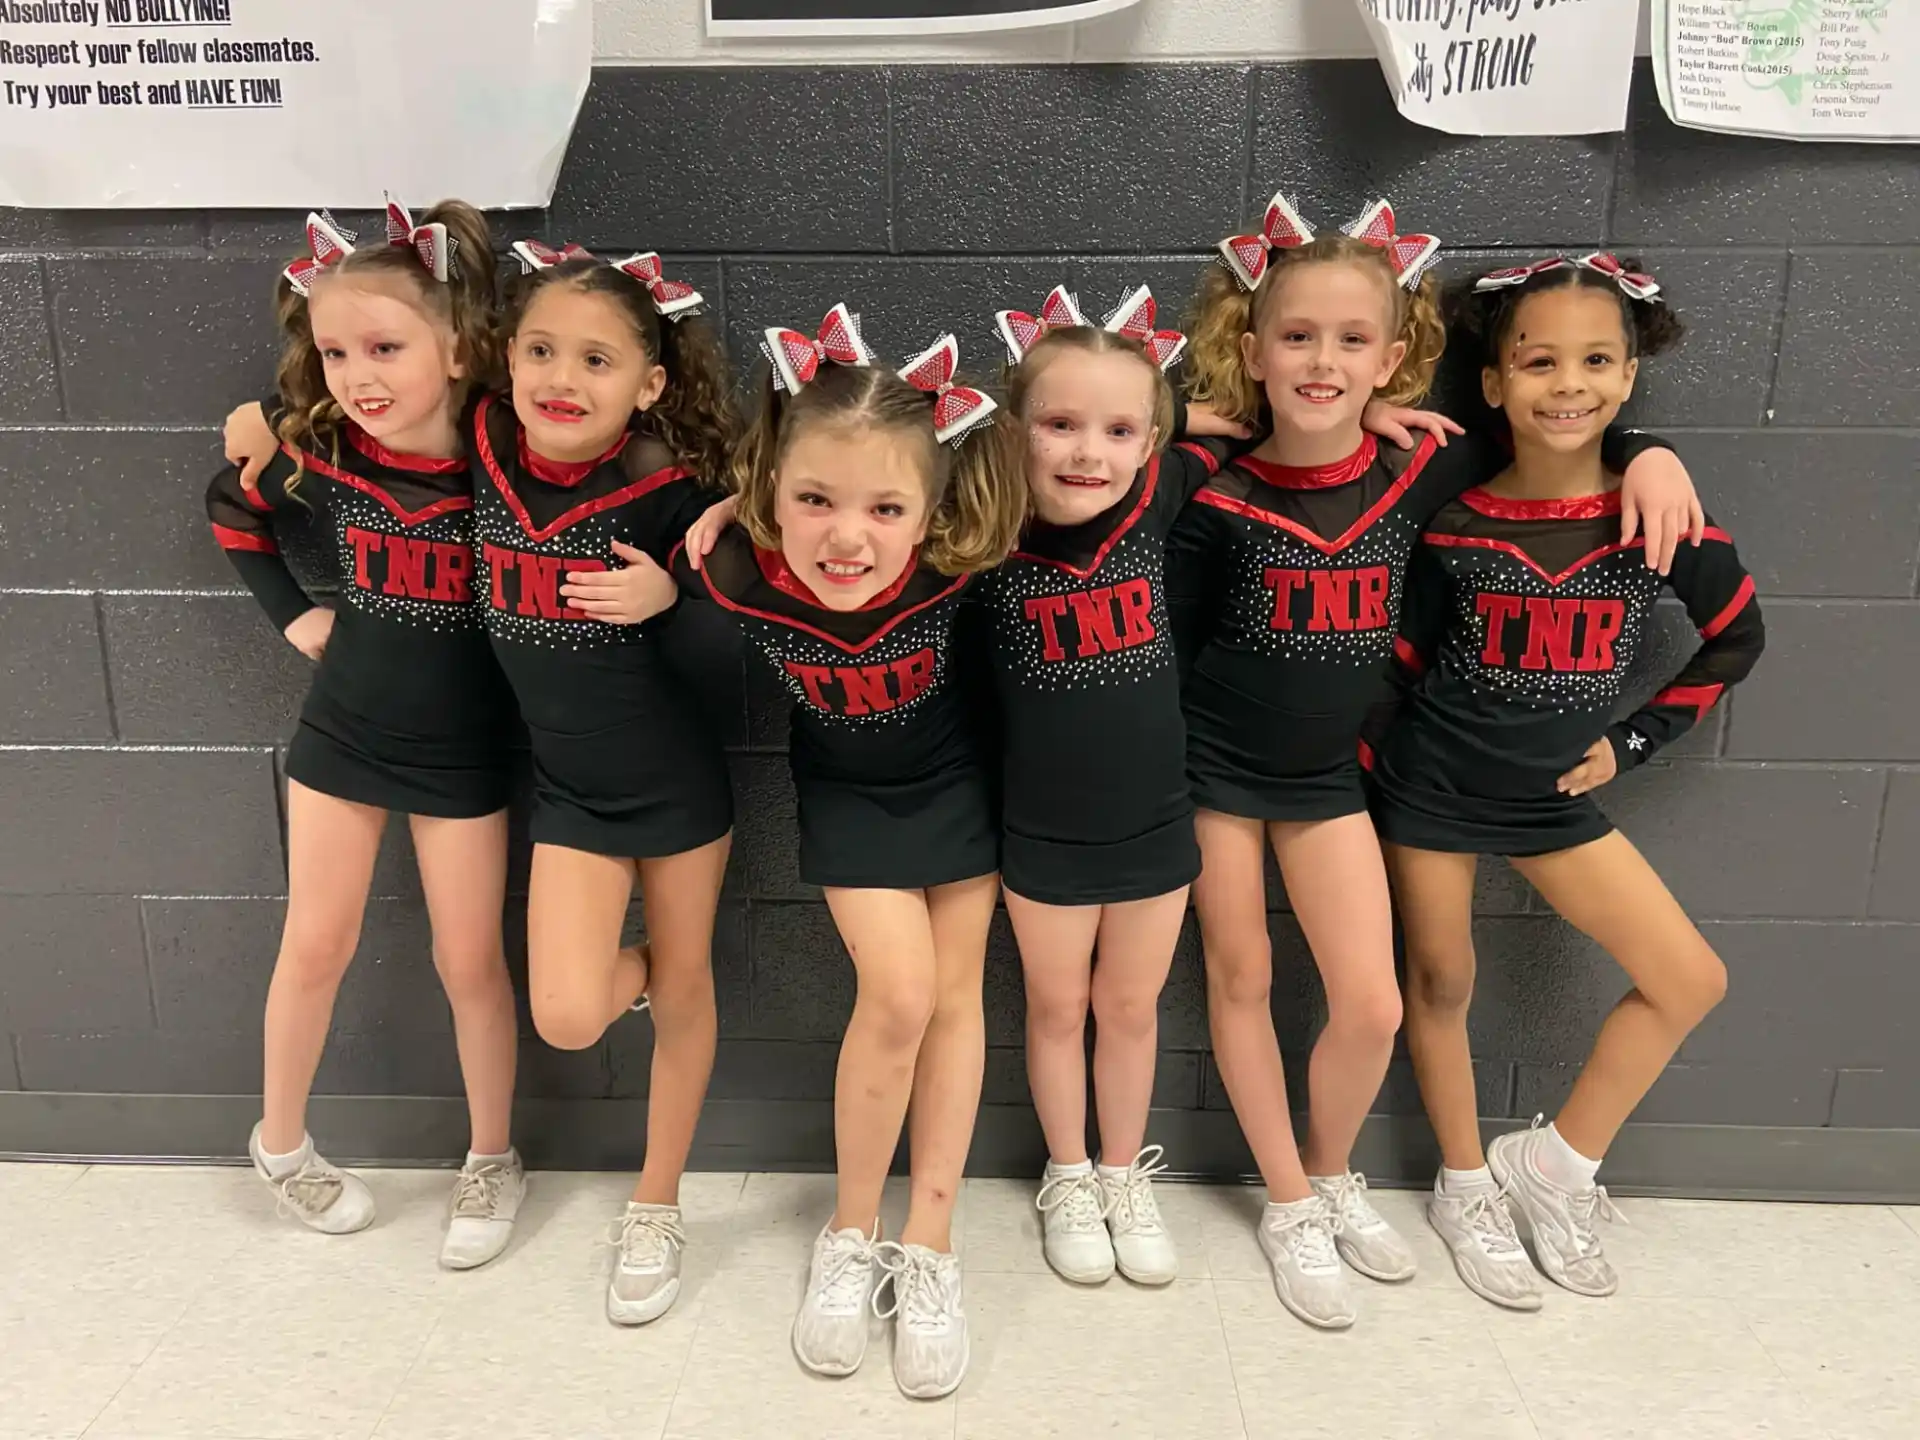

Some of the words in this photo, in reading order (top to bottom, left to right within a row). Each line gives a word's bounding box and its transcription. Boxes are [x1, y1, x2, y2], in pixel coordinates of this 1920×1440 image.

[0, 0, 98, 26] Absolutely
[106, 0, 132, 23] NO
[137, 0, 232, 22] BULLYING!
[1678, 4, 1700, 15] Hope
[1702, 5, 1726, 15] Black
[1820, 22, 1837, 33] Bill
[1677, 31, 1709, 44] Johnny
[1741, 36, 1773, 46] Brown
[1775, 36, 1804, 47] (2015)
[0, 40, 80, 68] Respect
[85, 43, 131, 68] your
[137, 39, 197, 65] fellow
[203, 37, 320, 63] classmates.
[1678, 45, 1705, 56] Robert
[1443, 32, 1537, 96] STRONG
[1679, 58, 1705, 70] Taylor
[1708, 61, 1739, 72] Barrett
[1815, 66, 1839, 76] Mark
[1699, 74, 1722, 84] Davis
[1813, 81, 1837, 90] Chris
[1840, 81, 1892, 92] Stephenson
[4, 80, 39, 109] Try
[45, 84, 91, 109] your
[97, 80, 142, 105] best
[147, 80, 181, 105] and
[187, 79, 236, 105] HAVE
[241, 78, 282, 104] FUN!
[1812, 108, 1831, 118] Tom
[1834, 108, 1867, 118] Weaver
[346, 526, 474, 602] TNR
[1264, 565, 1389, 632] TNR
[1024, 577, 1155, 662] TNR
[1476, 592, 1625, 672] TNR
[784, 648, 935, 716] TNR
